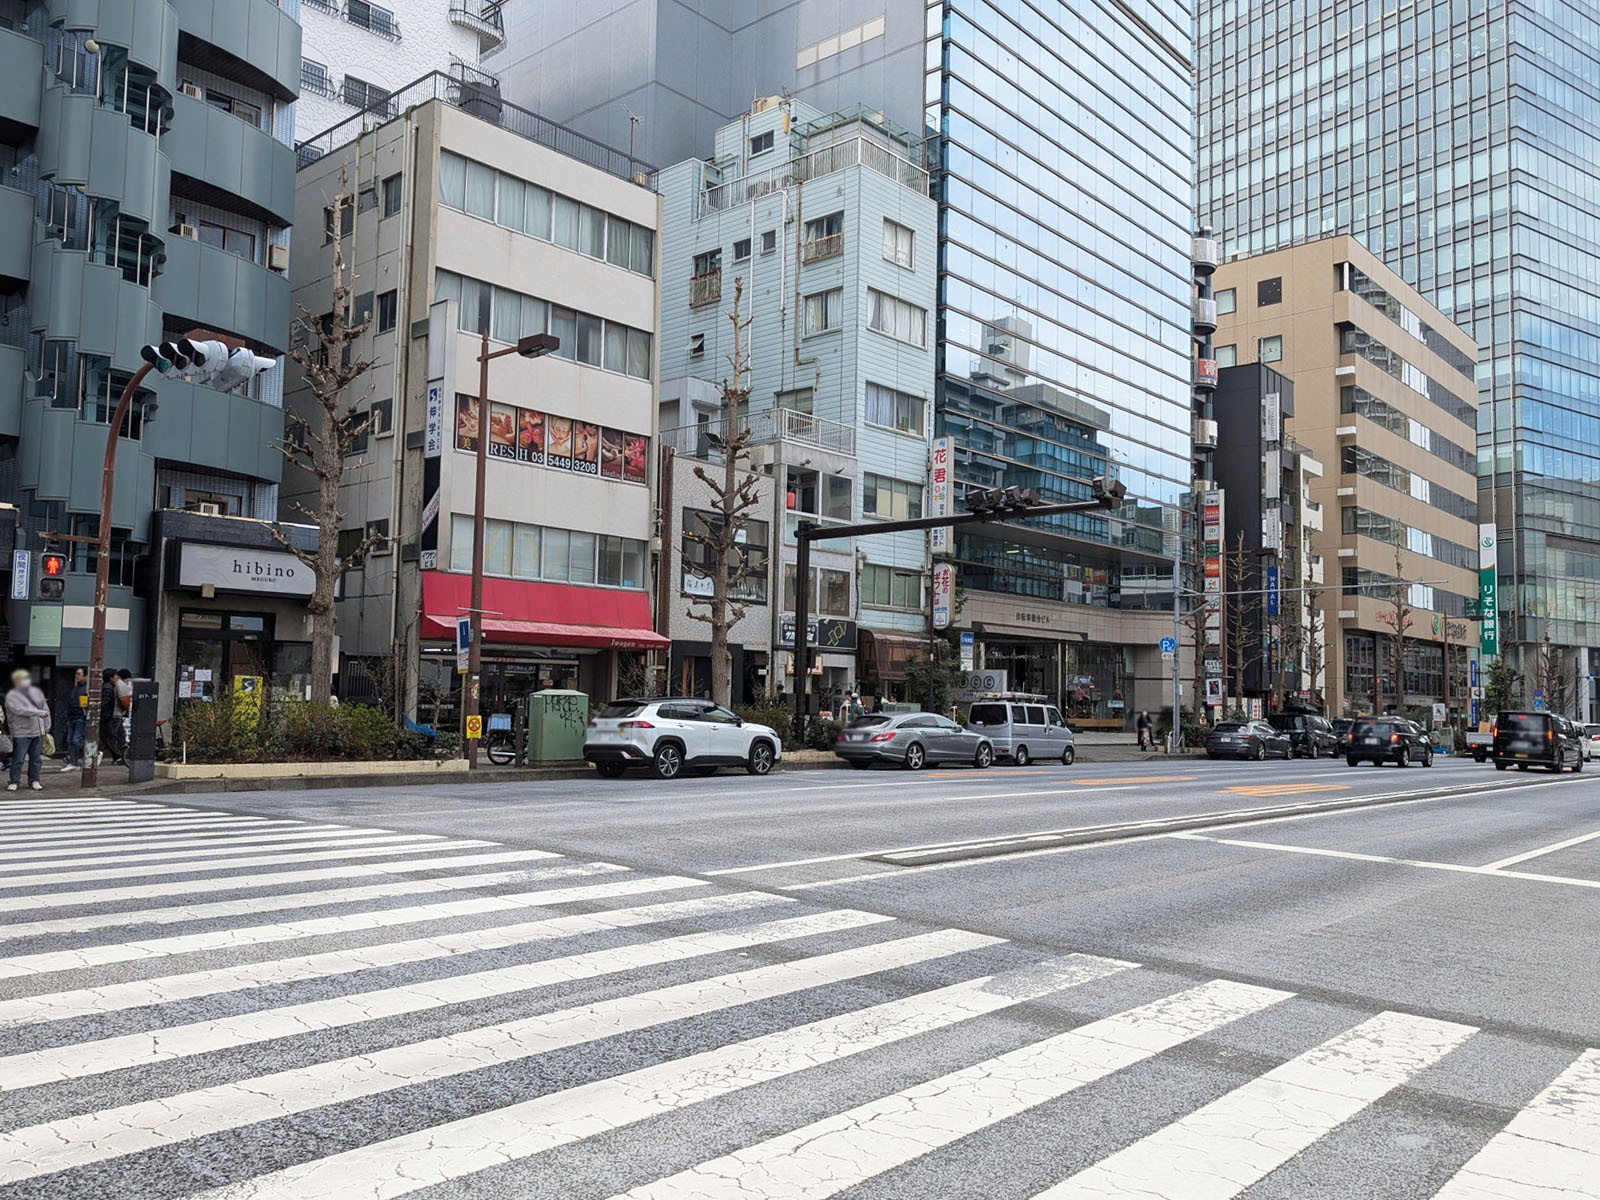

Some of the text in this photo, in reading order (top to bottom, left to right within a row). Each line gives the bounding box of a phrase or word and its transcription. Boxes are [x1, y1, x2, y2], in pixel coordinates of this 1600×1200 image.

[531, 451, 543, 463] 03
[548, 455, 571, 469] 5449
[574, 460, 597, 474] 3208
[934, 448, 946, 484] 花君
[233, 559, 295, 578] hibino
[1483, 584, 1495, 641] りそな銀行
[1162, 640, 1170, 651] P
